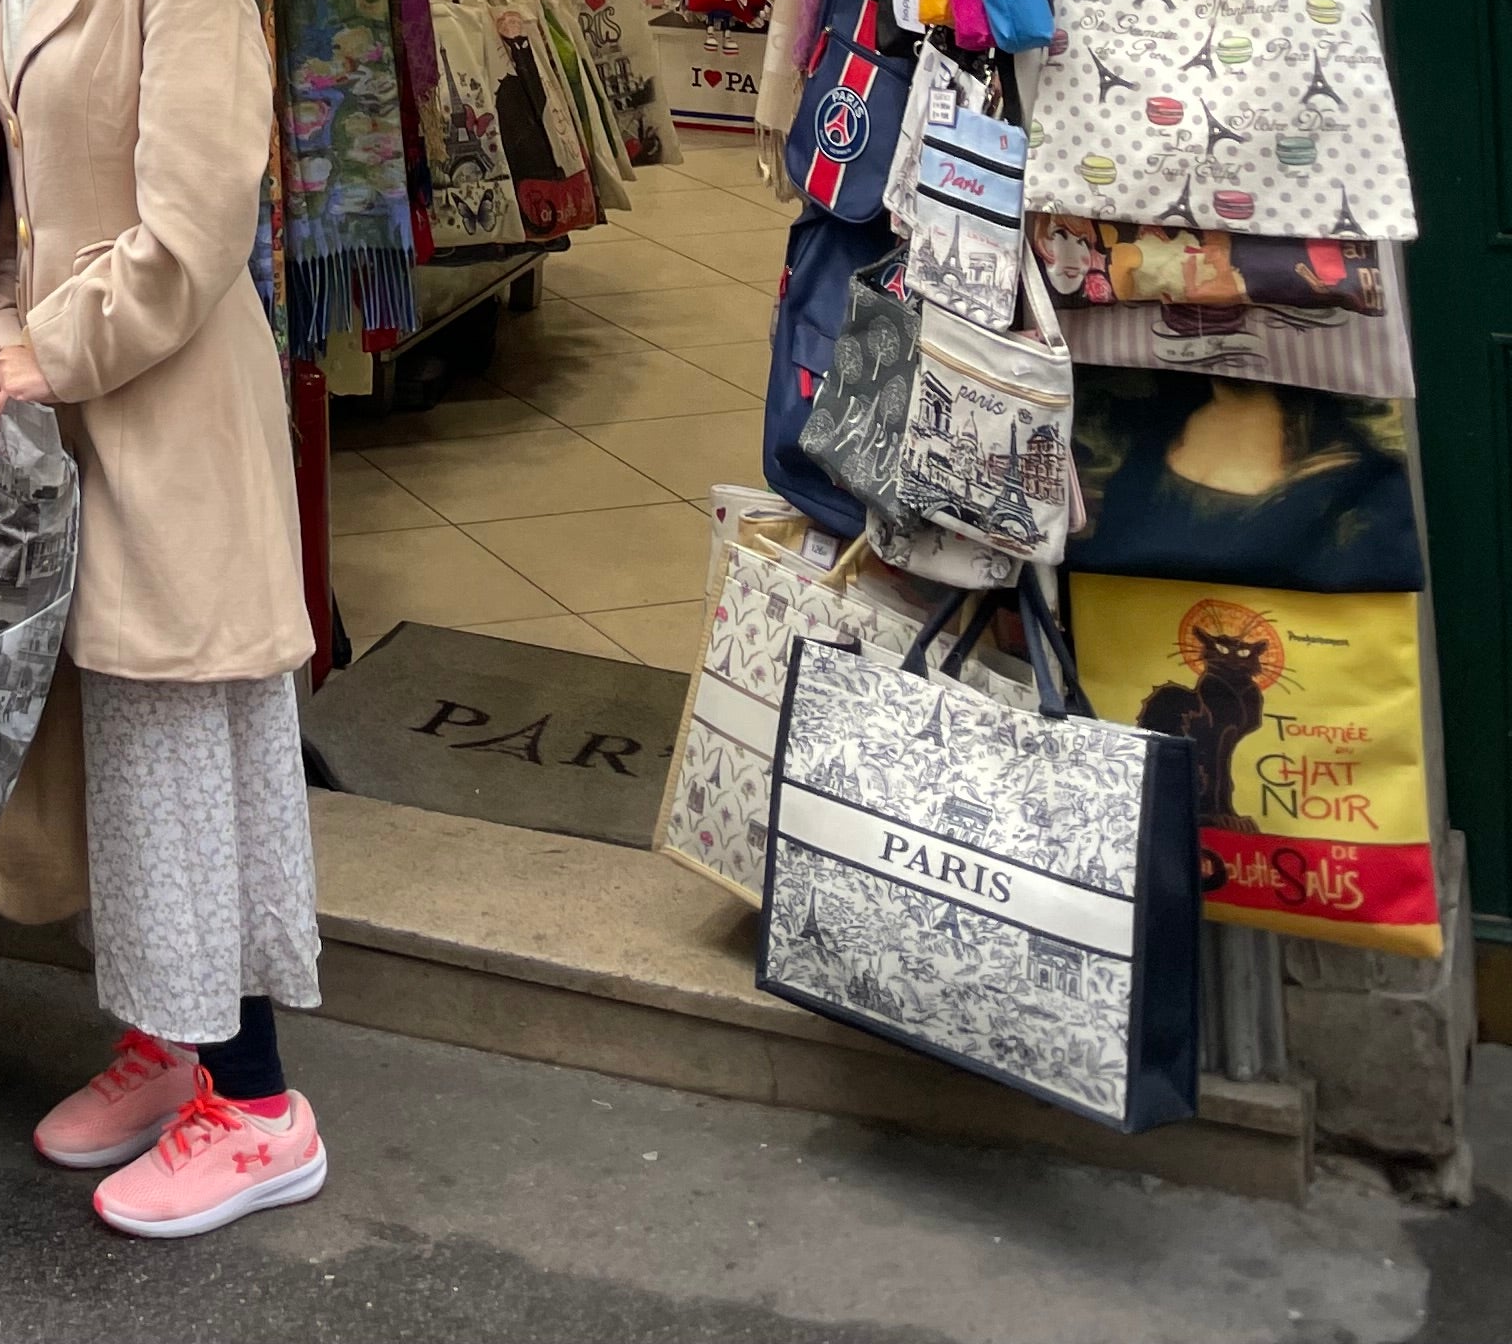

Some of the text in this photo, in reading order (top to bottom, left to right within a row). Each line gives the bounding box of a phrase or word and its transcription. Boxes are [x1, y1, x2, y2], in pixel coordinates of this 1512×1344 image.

[830, 90, 866, 119] PARIS
[938, 162, 986, 197] Paris
[954, 384, 1007, 417] paris
[1262, 712, 1373, 743] TOURNÉE
[1255, 752, 1363, 798] CHAT
[1260, 782, 1380, 831] NOIR
[876, 828, 1013, 906] PARIS
[1330, 844, 1359, 862] DE
